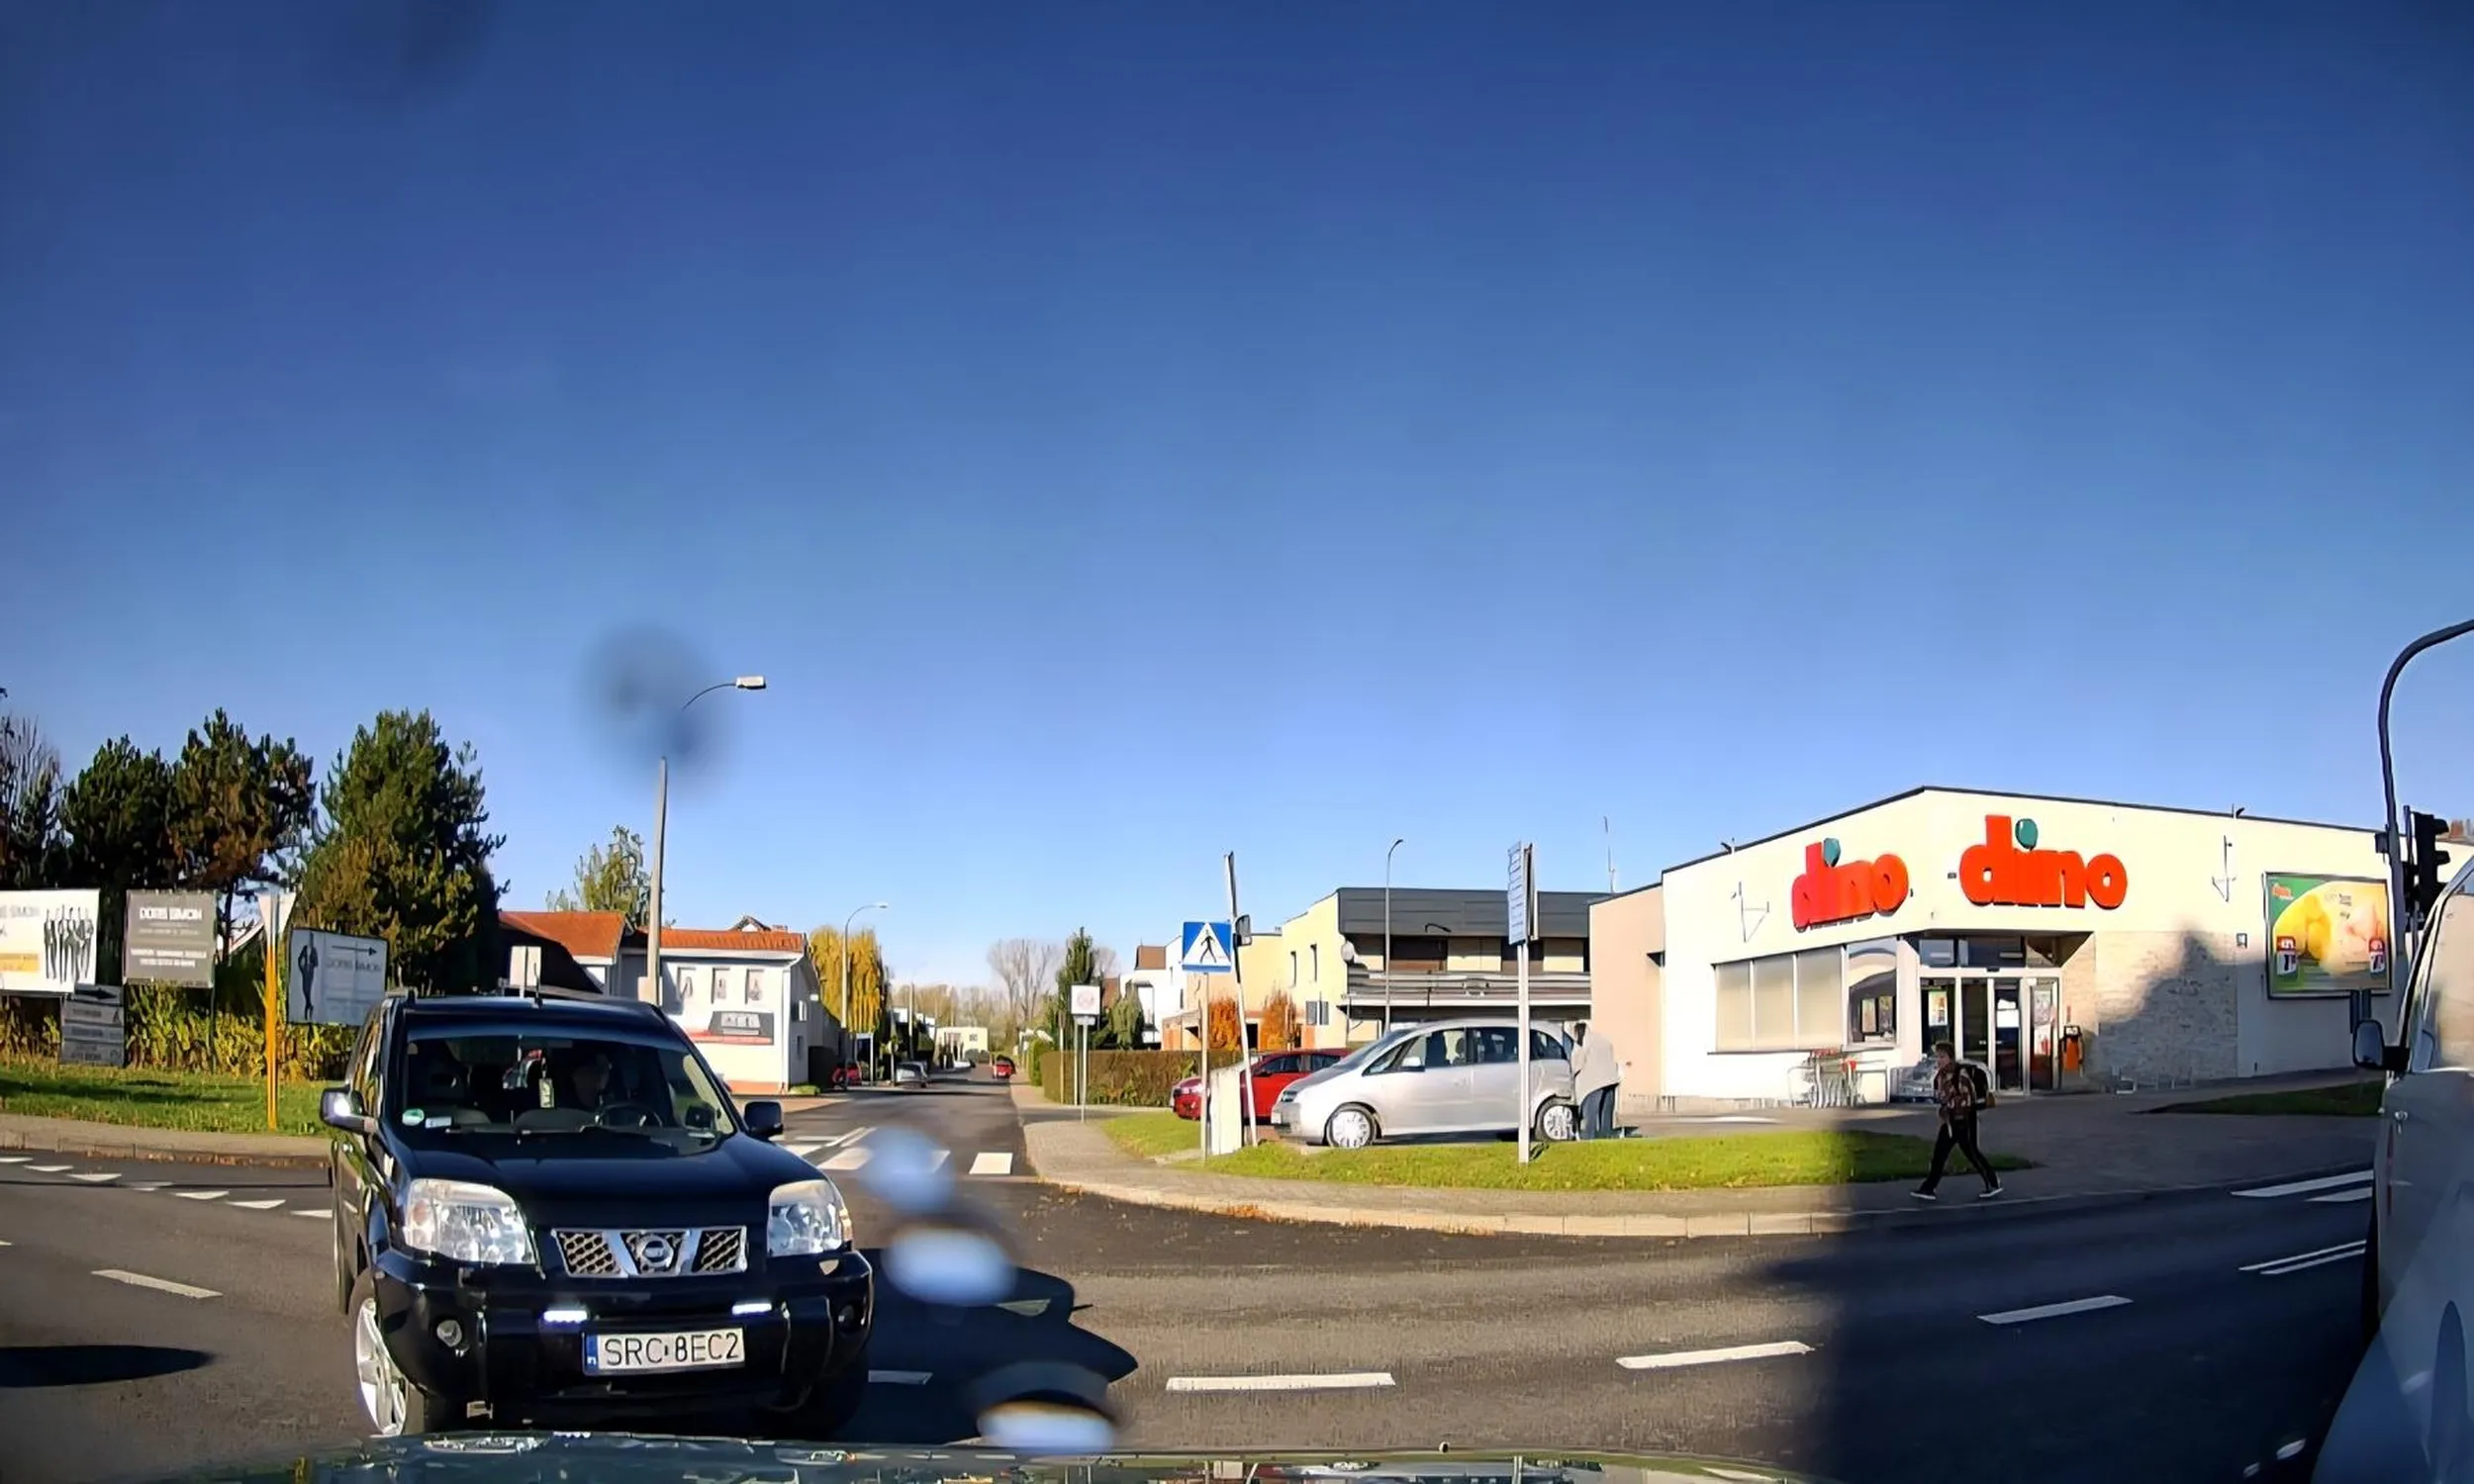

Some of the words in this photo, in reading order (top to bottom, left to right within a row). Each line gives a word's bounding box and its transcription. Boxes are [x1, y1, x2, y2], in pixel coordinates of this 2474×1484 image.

[1791, 838, 1909, 932] dino
[1958, 815, 2128, 909] dino
[605, 1338, 663, 1365] SRC
[675, 1332, 739, 1362] 8EC2
